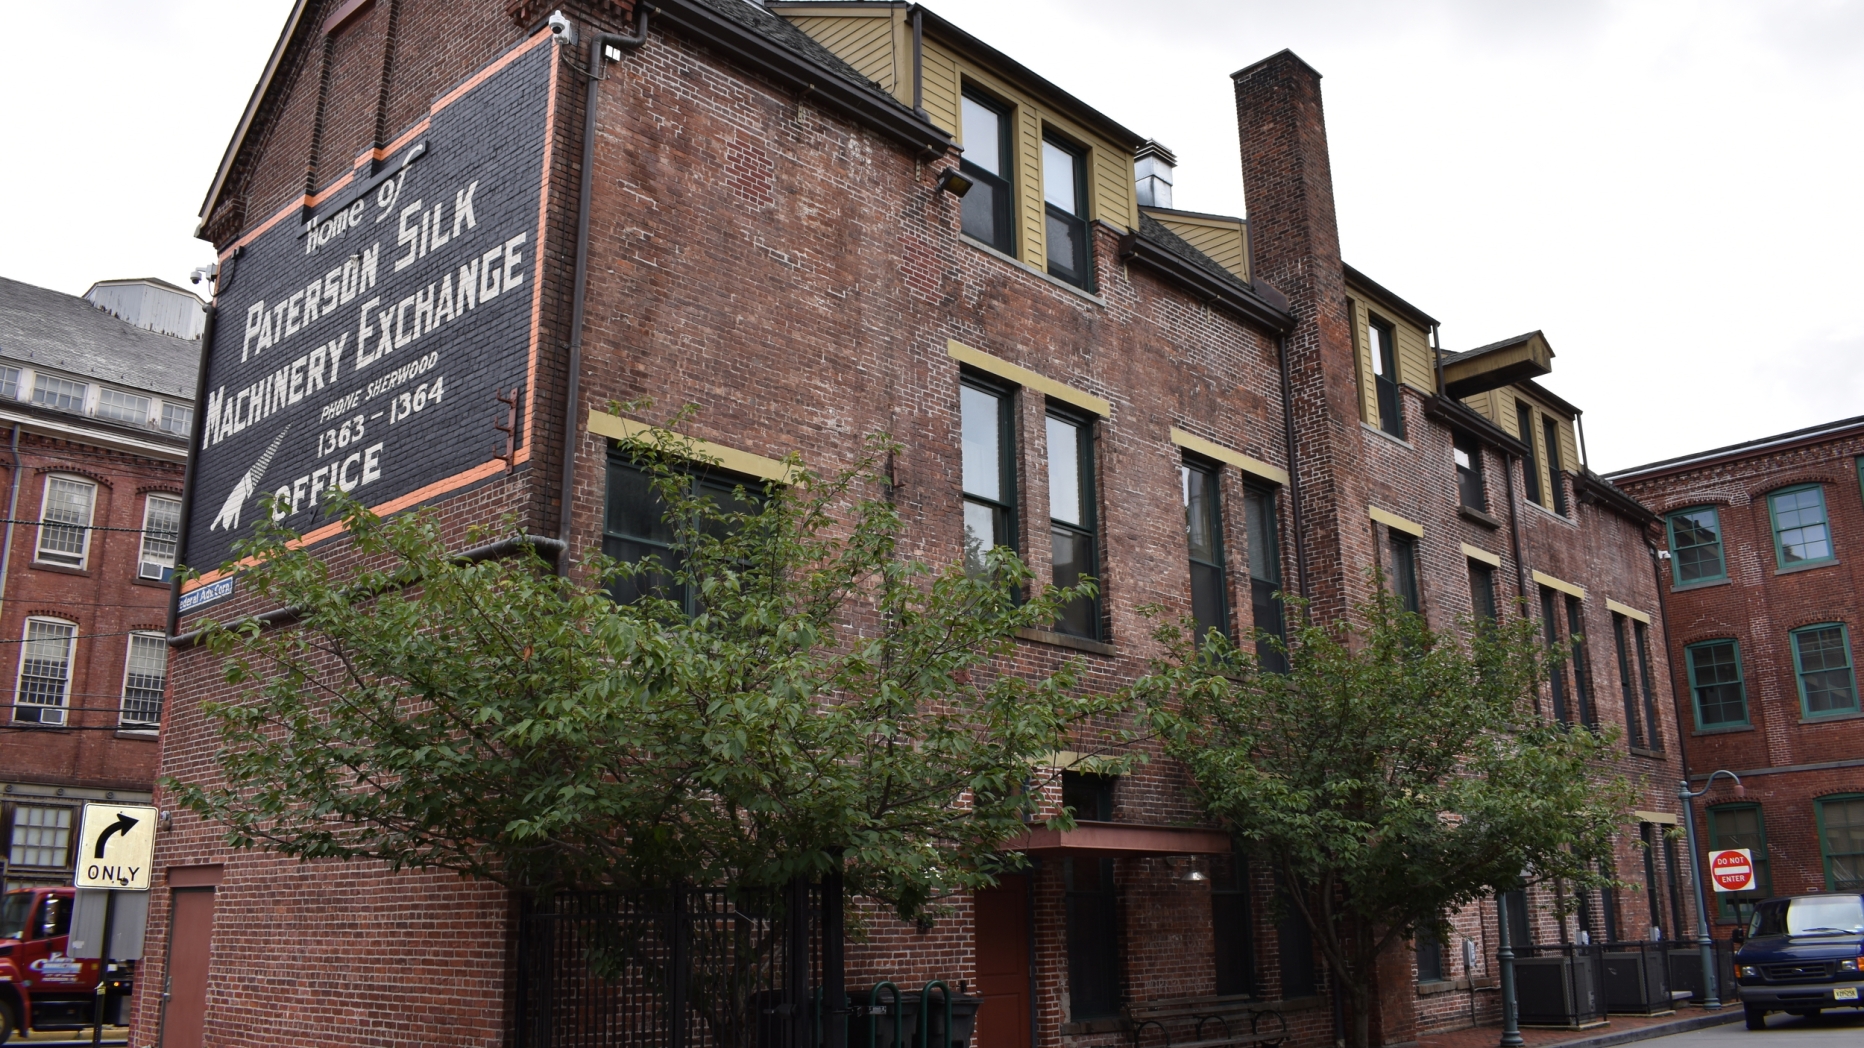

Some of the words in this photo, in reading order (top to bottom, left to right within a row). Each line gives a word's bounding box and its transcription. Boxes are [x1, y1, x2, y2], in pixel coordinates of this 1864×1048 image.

[306, 199, 365, 255] Home
[376, 144, 423, 223] of
[241, 242, 380, 364] PATERSON
[395, 180, 479, 272] SILK
[202, 331, 349, 450] MACHINERY
[356, 232, 527, 371] EXCHANGE
[317, 414, 365, 458] 1363
[389, 376, 445, 425] 1364
[320, 390, 362, 424] PHONE
[365, 351, 439, 400] SHERWOOD
[272, 442, 384, 522] OFFICE
[88, 865, 140, 881] ONLY
[1721, 875, 1745, 883] ENTER
